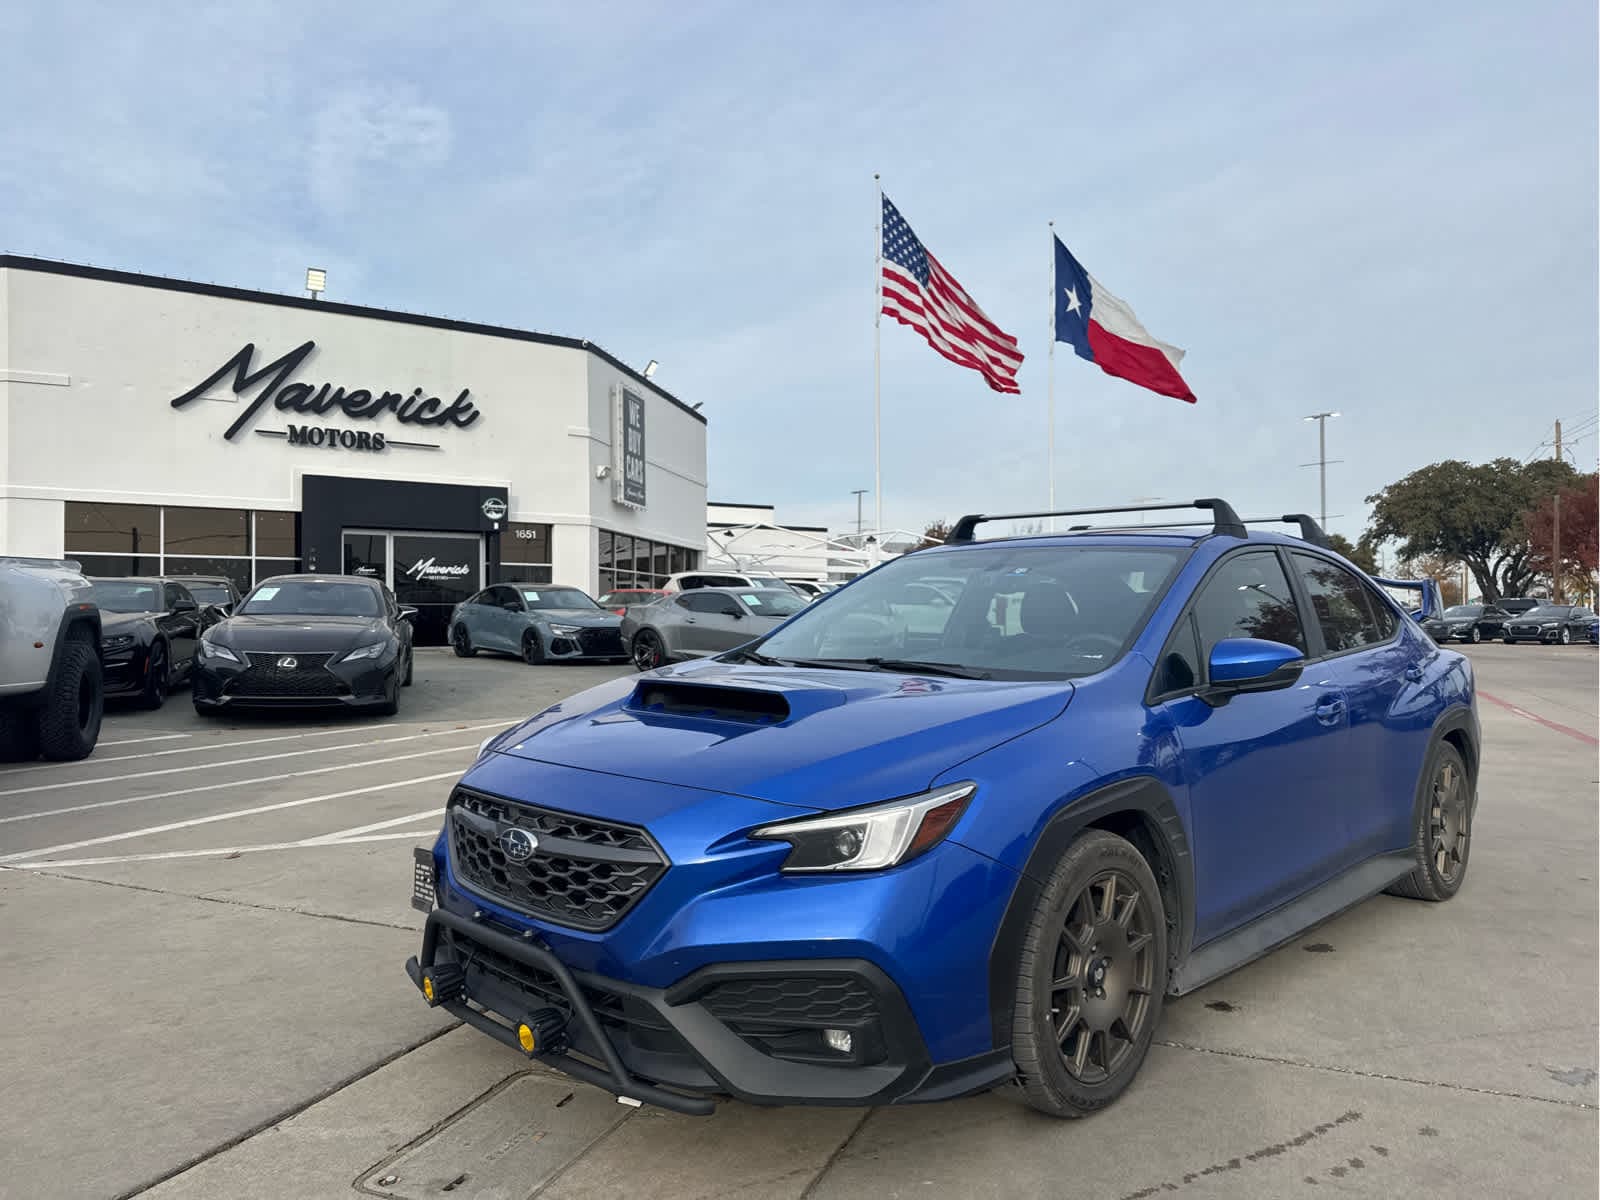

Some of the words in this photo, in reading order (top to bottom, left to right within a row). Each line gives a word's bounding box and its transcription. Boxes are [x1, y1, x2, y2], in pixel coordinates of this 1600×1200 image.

[171, 340, 480, 440] Maverick
[628, 399, 641, 428] WE
[287, 424, 386, 450] MOTORS
[626, 454, 644, 485] CARS
[514, 529, 537, 539] 1651
[406, 557, 470, 580] Maverick
